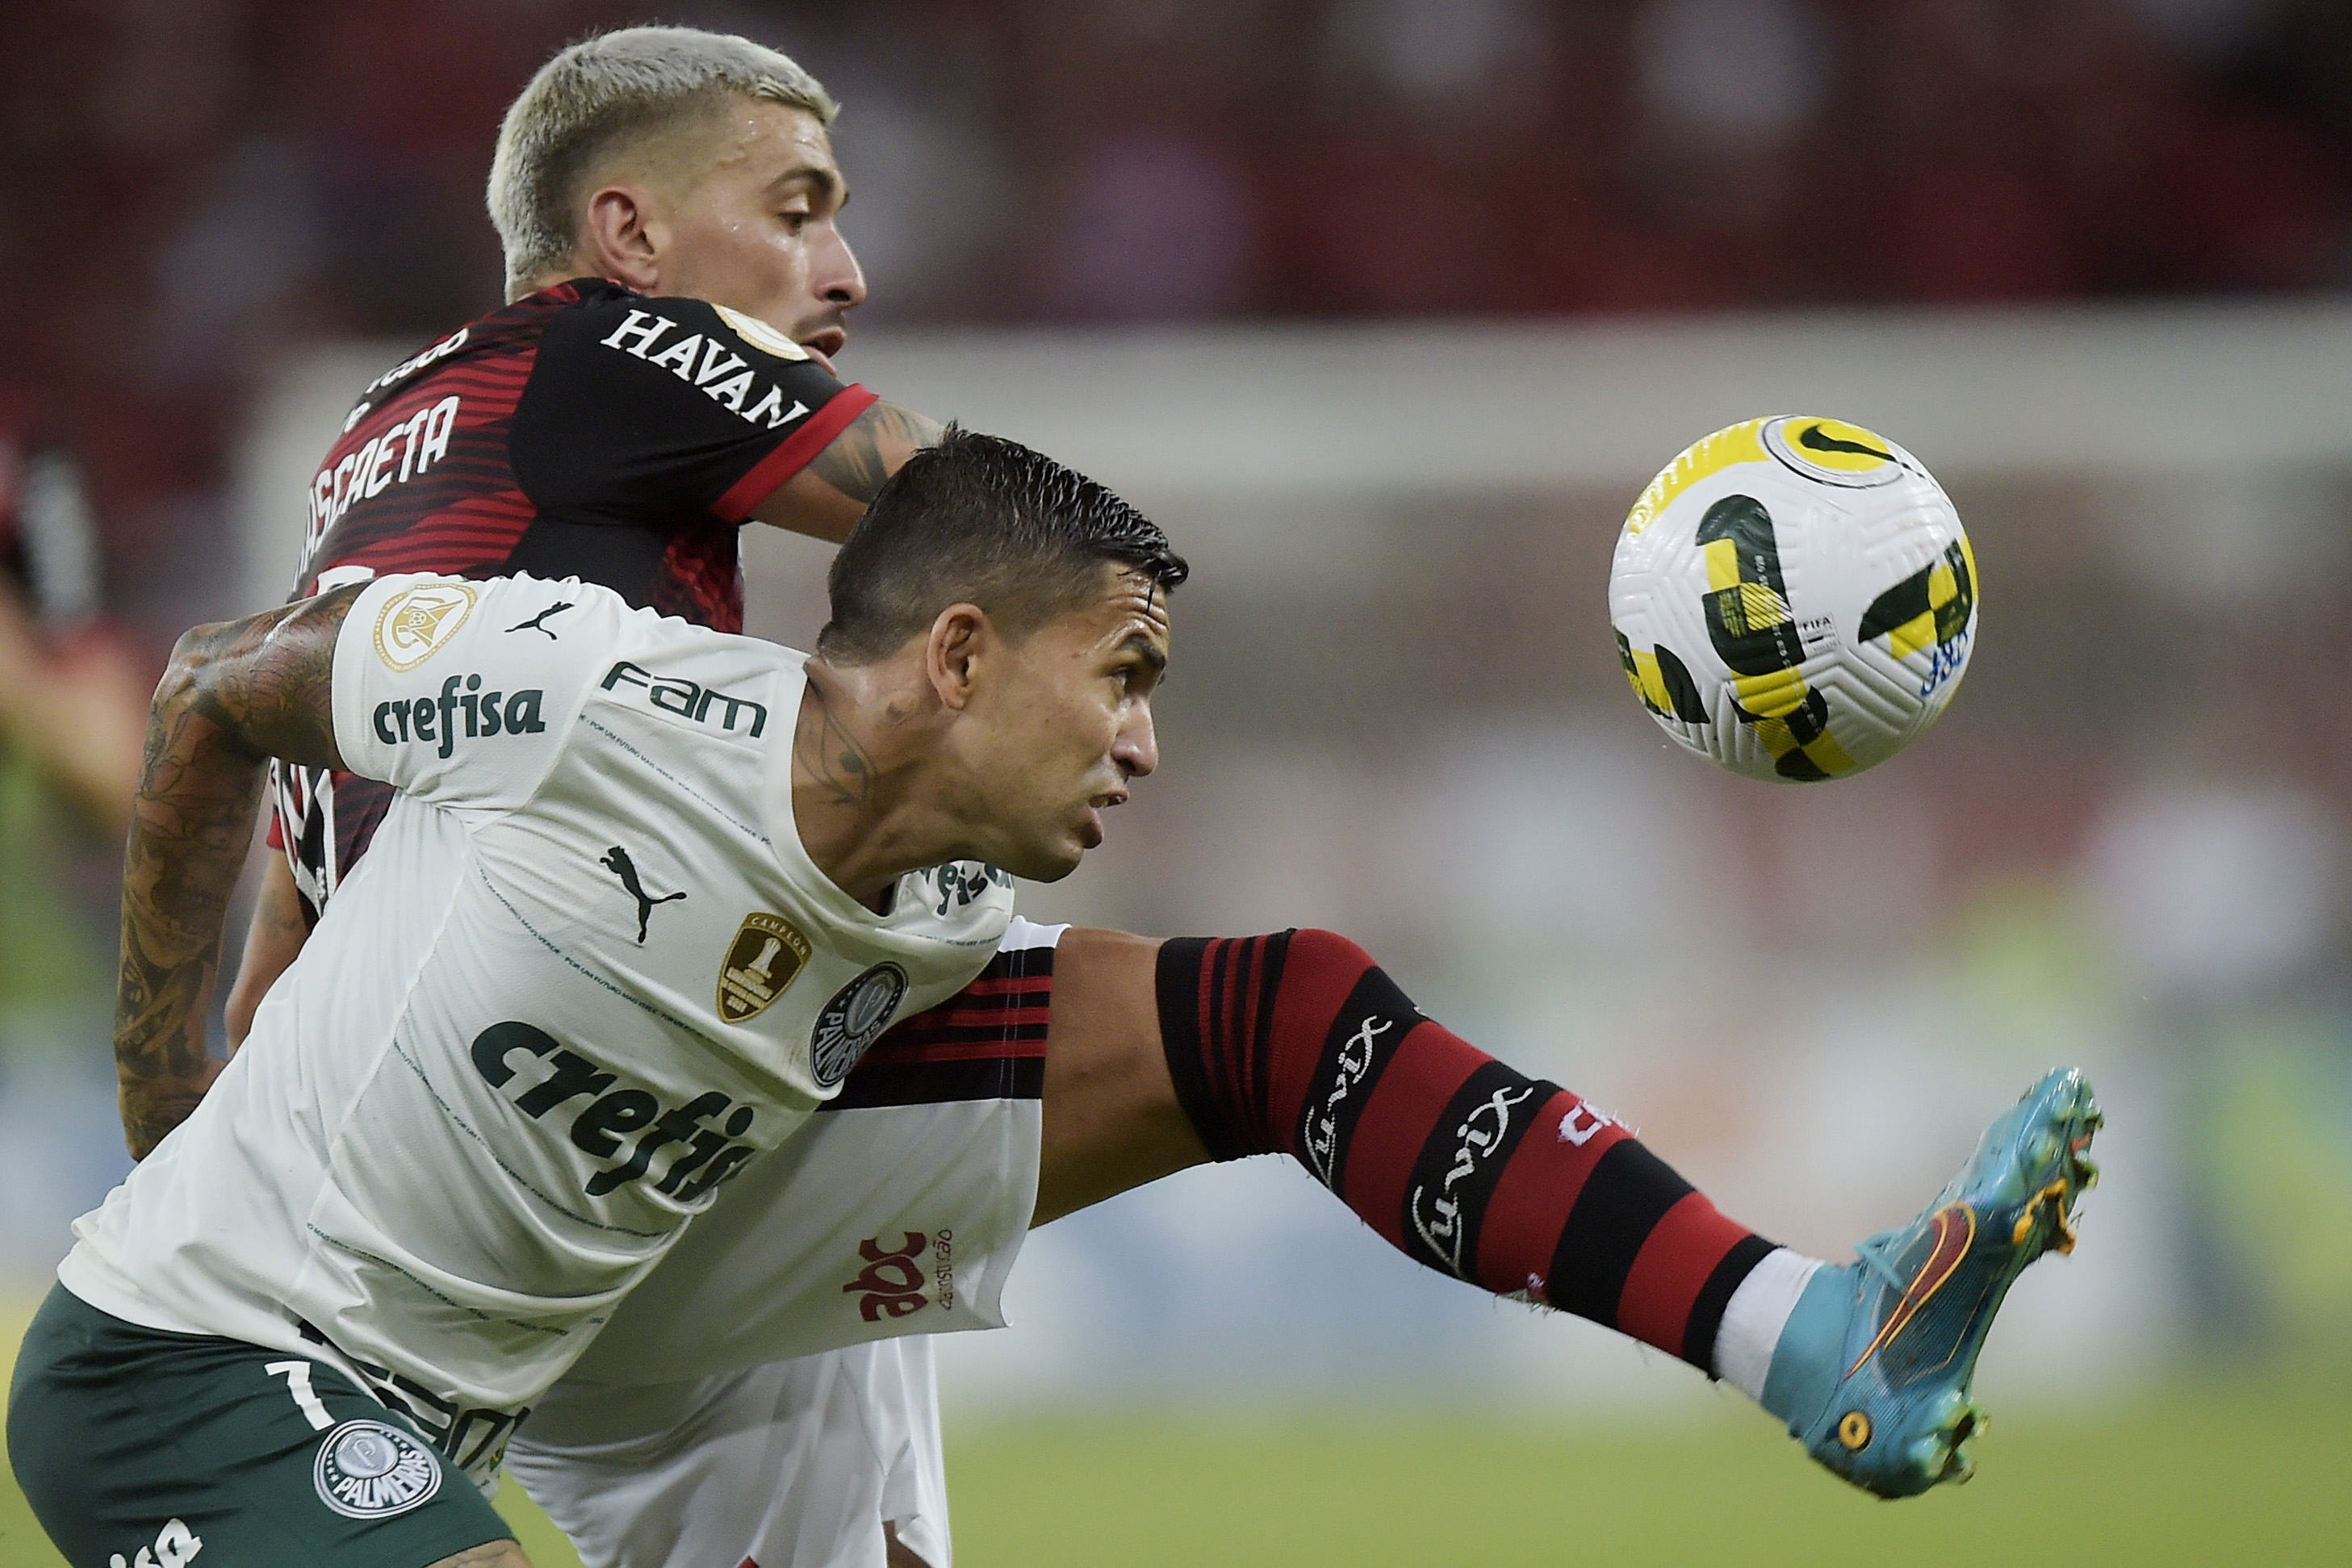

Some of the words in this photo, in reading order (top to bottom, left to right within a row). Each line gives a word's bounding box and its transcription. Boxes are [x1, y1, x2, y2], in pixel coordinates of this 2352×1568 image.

[601, 308, 810, 430] HAVAN
[1802, 617, 1831, 631] FIFA
[373, 674, 546, 760] crefisa
[843, 1231, 928, 1323] abc
[263, 1361, 337, 1432] 7
[333, 1449, 430, 1509] PALMEIRAS
